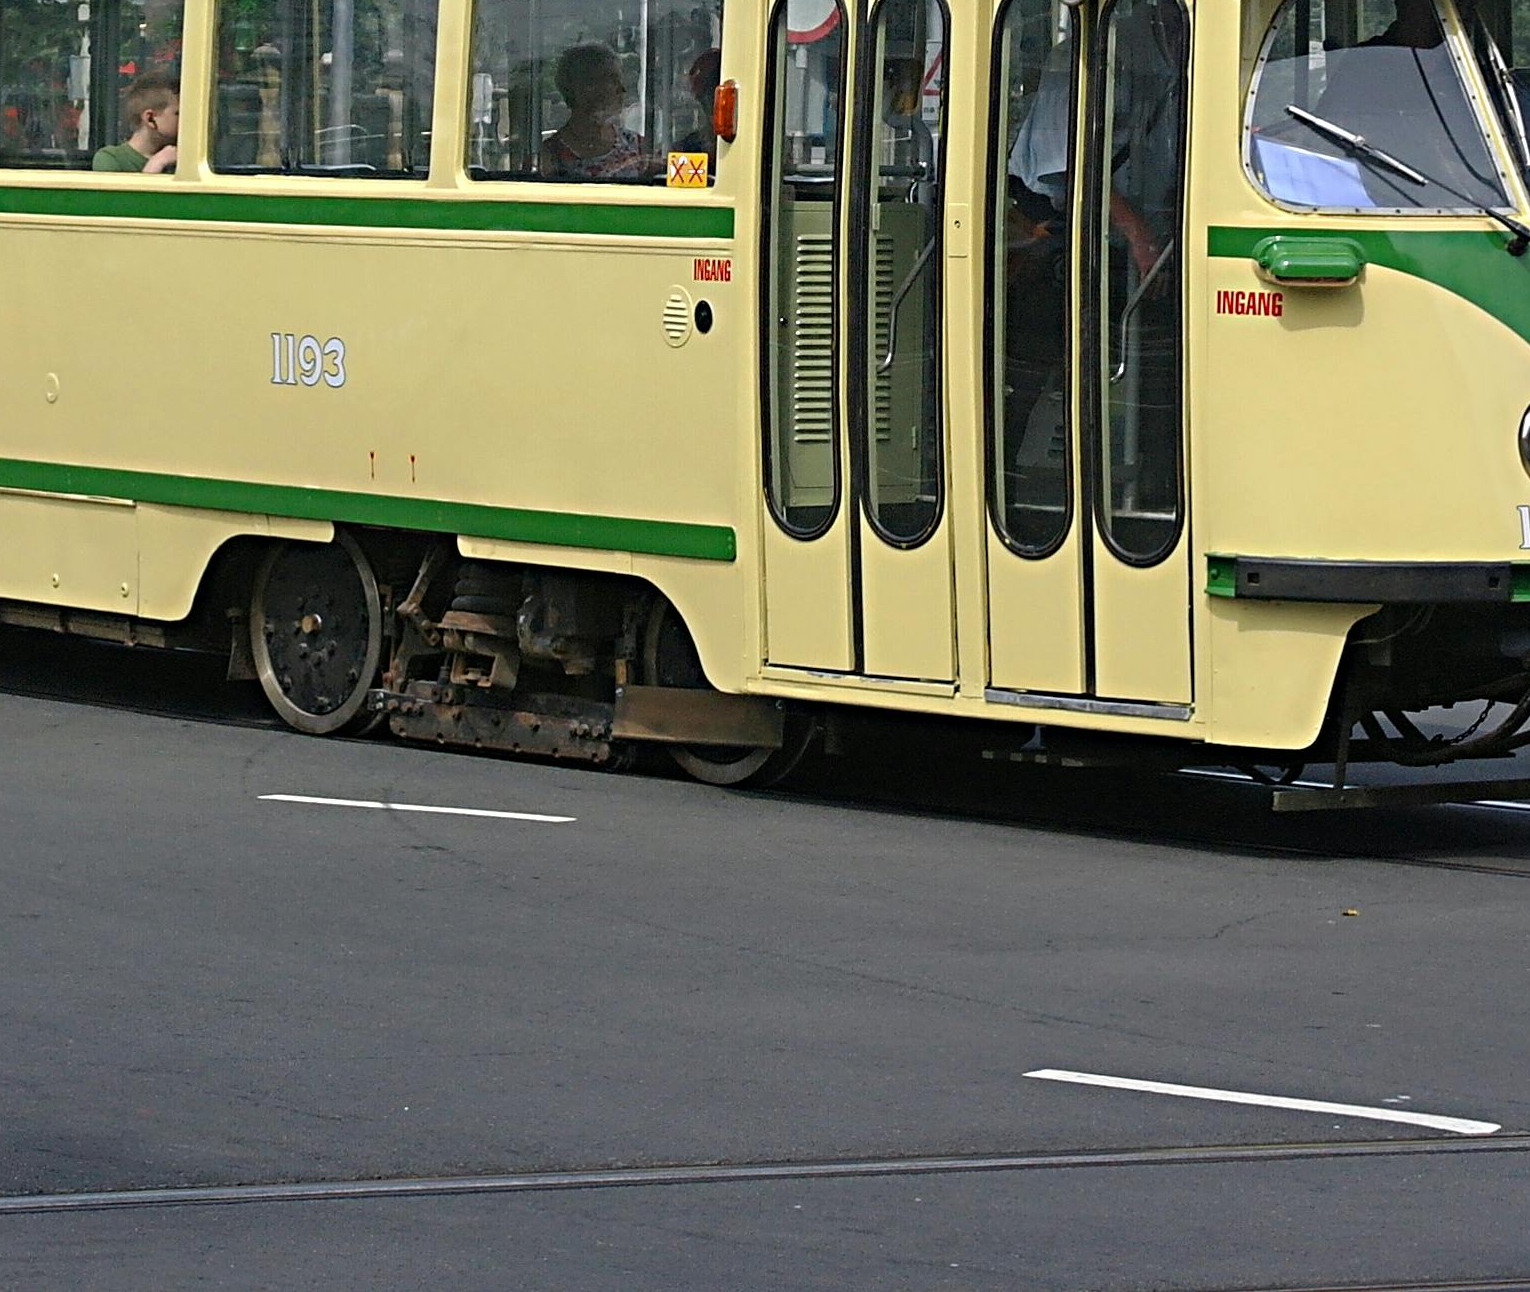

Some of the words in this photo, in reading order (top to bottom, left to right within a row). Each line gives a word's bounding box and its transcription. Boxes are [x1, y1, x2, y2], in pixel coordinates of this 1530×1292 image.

[694, 258, 731, 282] INGANG
[1216, 290, 1284, 317] INGANG
[270, 332, 347, 389] 1193
